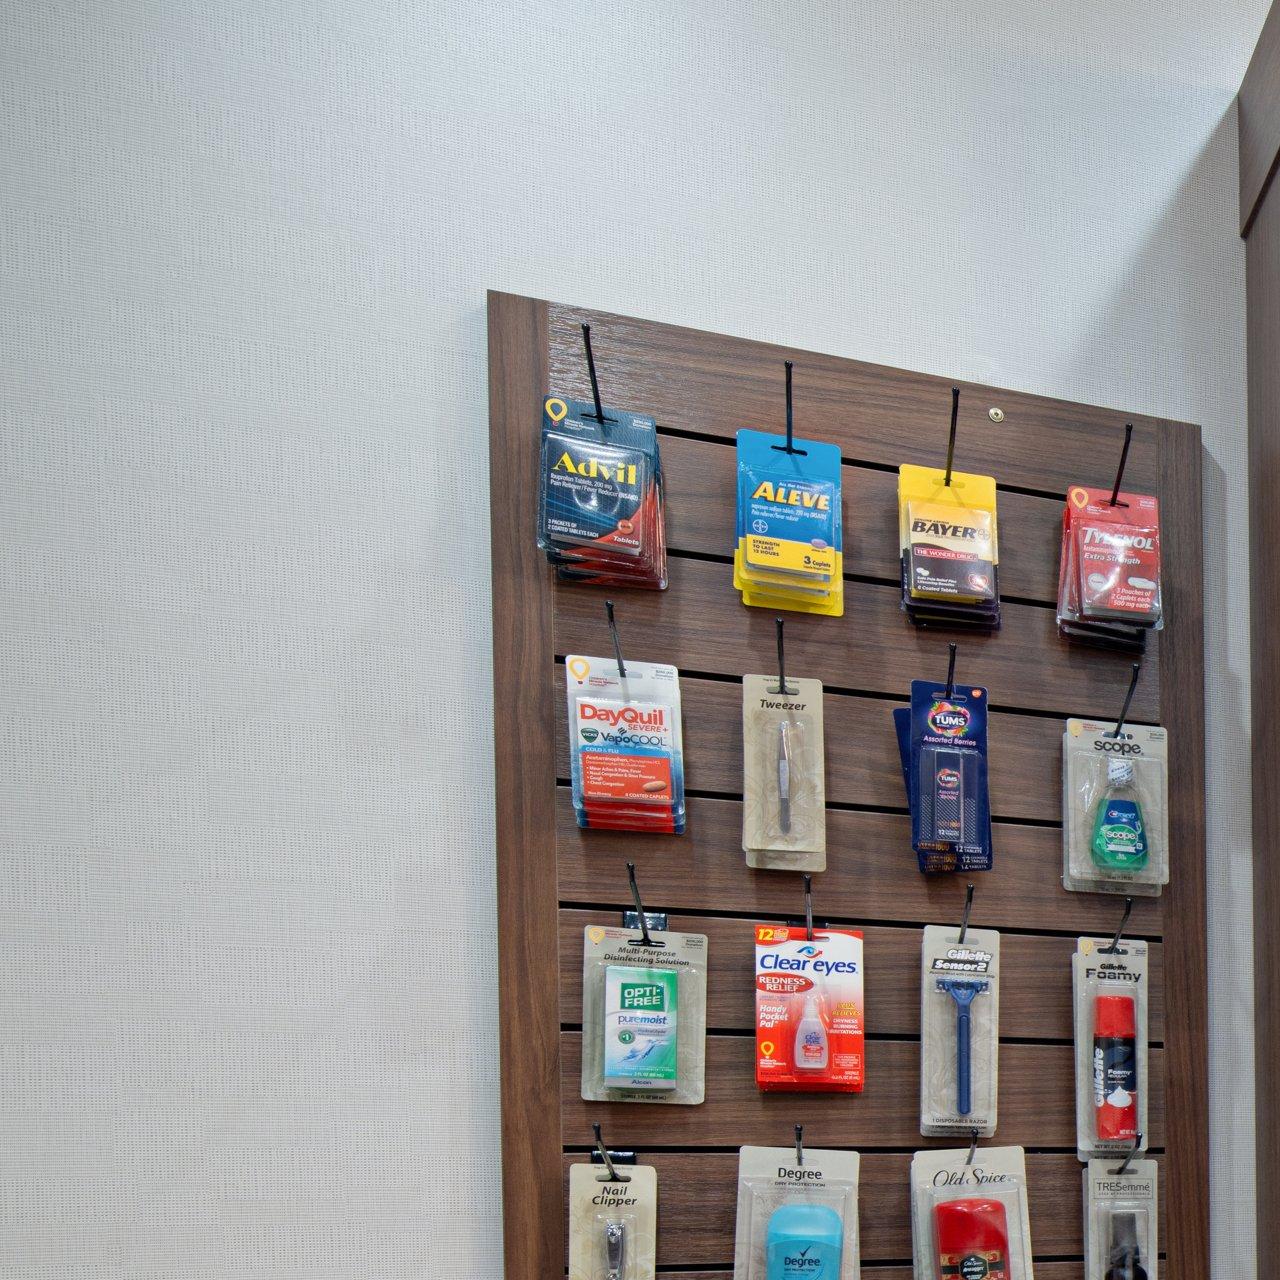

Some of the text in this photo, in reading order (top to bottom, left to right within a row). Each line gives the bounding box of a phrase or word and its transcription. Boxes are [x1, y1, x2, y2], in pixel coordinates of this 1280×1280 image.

[551, 452, 637, 485] Advil
[752, 481, 830, 510] ALEVE
[912, 520, 977, 539] BAYER
[613, 535, 639, 546] Tablets
[929, 550, 956, 559] WONDER
[1085, 553, 1104, 561] Extra
[804, 556, 830, 568] 3 Caplets
[759, 699, 807, 712] Tweezer
[580, 703, 664, 726] DayQuil
[934, 715, 965, 726] TUMS
[628, 724, 662, 733] SEVERE
[923, 735, 952, 744] Assorted
[1094, 740, 1142, 755] scope
[758, 928, 774, 941] 12
[618, 947, 676, 958] Multi-Purpose
[947, 949, 992, 961] Gillette
[604, 953, 690, 966] Disinfecting Solution
[759, 954, 856, 976] Clear eyes
[933, 960, 987, 971] Sensor2
[1100, 963, 1127, 971] Gillette
[759, 976, 806, 986] REDNESS
[1085, 968, 1141, 983] Foamy
[624, 987, 660, 998] OPTI-
[625, 996, 660, 1008] FREE
[759, 1005, 787, 1013] Handy
[618, 1015, 667, 1025] puremoist
[759, 1013, 789, 1021] Pocket
[759, 1020, 775, 1028] Pal
[1094, 1048, 1104, 1107] Gillette
[778, 1168, 823, 1181] Degree
[933, 1168, 1007, 1187] Old Spice
[602, 1186, 627, 1196] Nail
[1096, 1182, 1150, 1191] TRESemmé
[592, 1196, 638, 1208] Clipper
[784, 1256, 821, 1268] Degree
